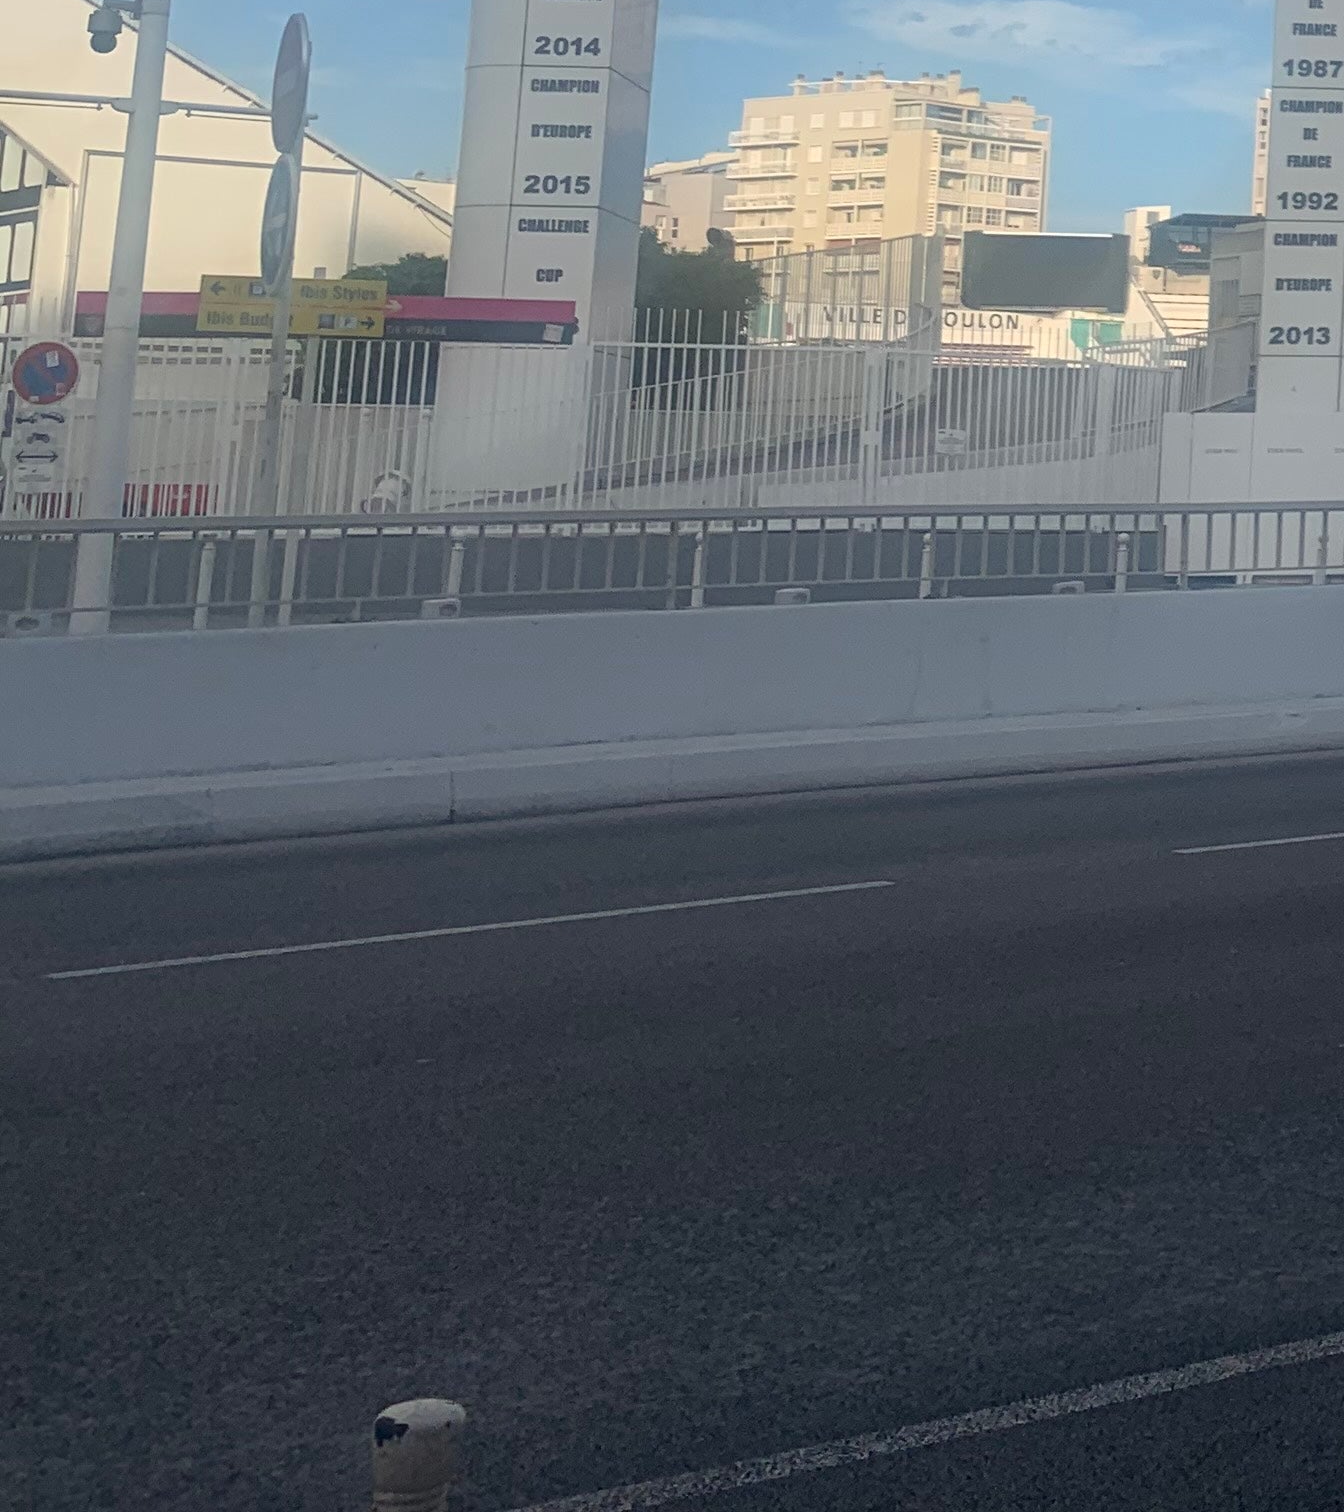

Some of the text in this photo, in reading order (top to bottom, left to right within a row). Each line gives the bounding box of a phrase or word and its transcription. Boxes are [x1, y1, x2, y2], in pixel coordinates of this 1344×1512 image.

[1292, 22, 1337, 37] FRANCE
[534, 36, 601, 57] 2014
[1283, 59, 1344, 78] 1987
[531, 78, 600, 94] CHAMPION
[1280, 99, 1343, 114] CHAMPION
[531, 123, 592, 139] D'EUROPE
[1303, 127, 1318, 141] DE
[1287, 155, 1332, 168] FRANCE
[523, 175, 591, 195] 2015
[1277, 191, 1338, 211] 1992
[518, 218, 590, 233] CHALLENGE
[1273, 233, 1338, 247] CHAMPION
[536, 268, 564, 282] CUP
[1275, 278, 1332, 292] D'EUROPE
[333, 285, 378, 303] Styles
[943, 310, 1020, 330] OULON
[1268, 326, 1331, 345] 2013
